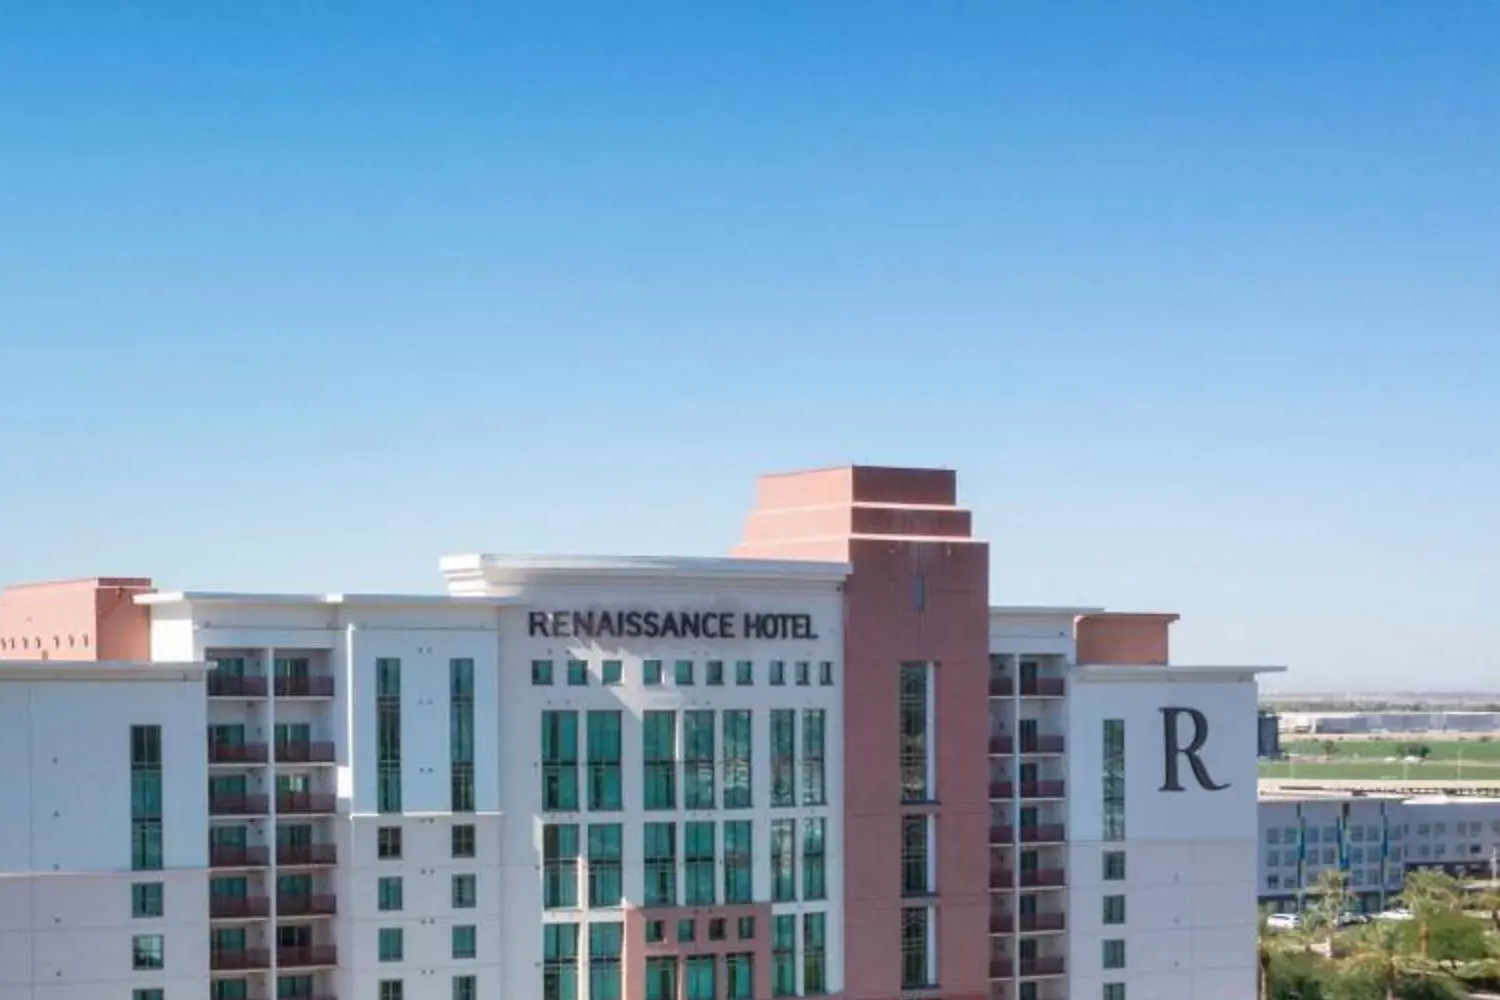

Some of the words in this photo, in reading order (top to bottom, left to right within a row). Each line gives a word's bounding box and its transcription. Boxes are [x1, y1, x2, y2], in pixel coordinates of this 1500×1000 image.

[528, 610, 735, 638] RENAISSANCE
[743, 612, 819, 640] HOTEL
[1157, 706, 1233, 792] R
